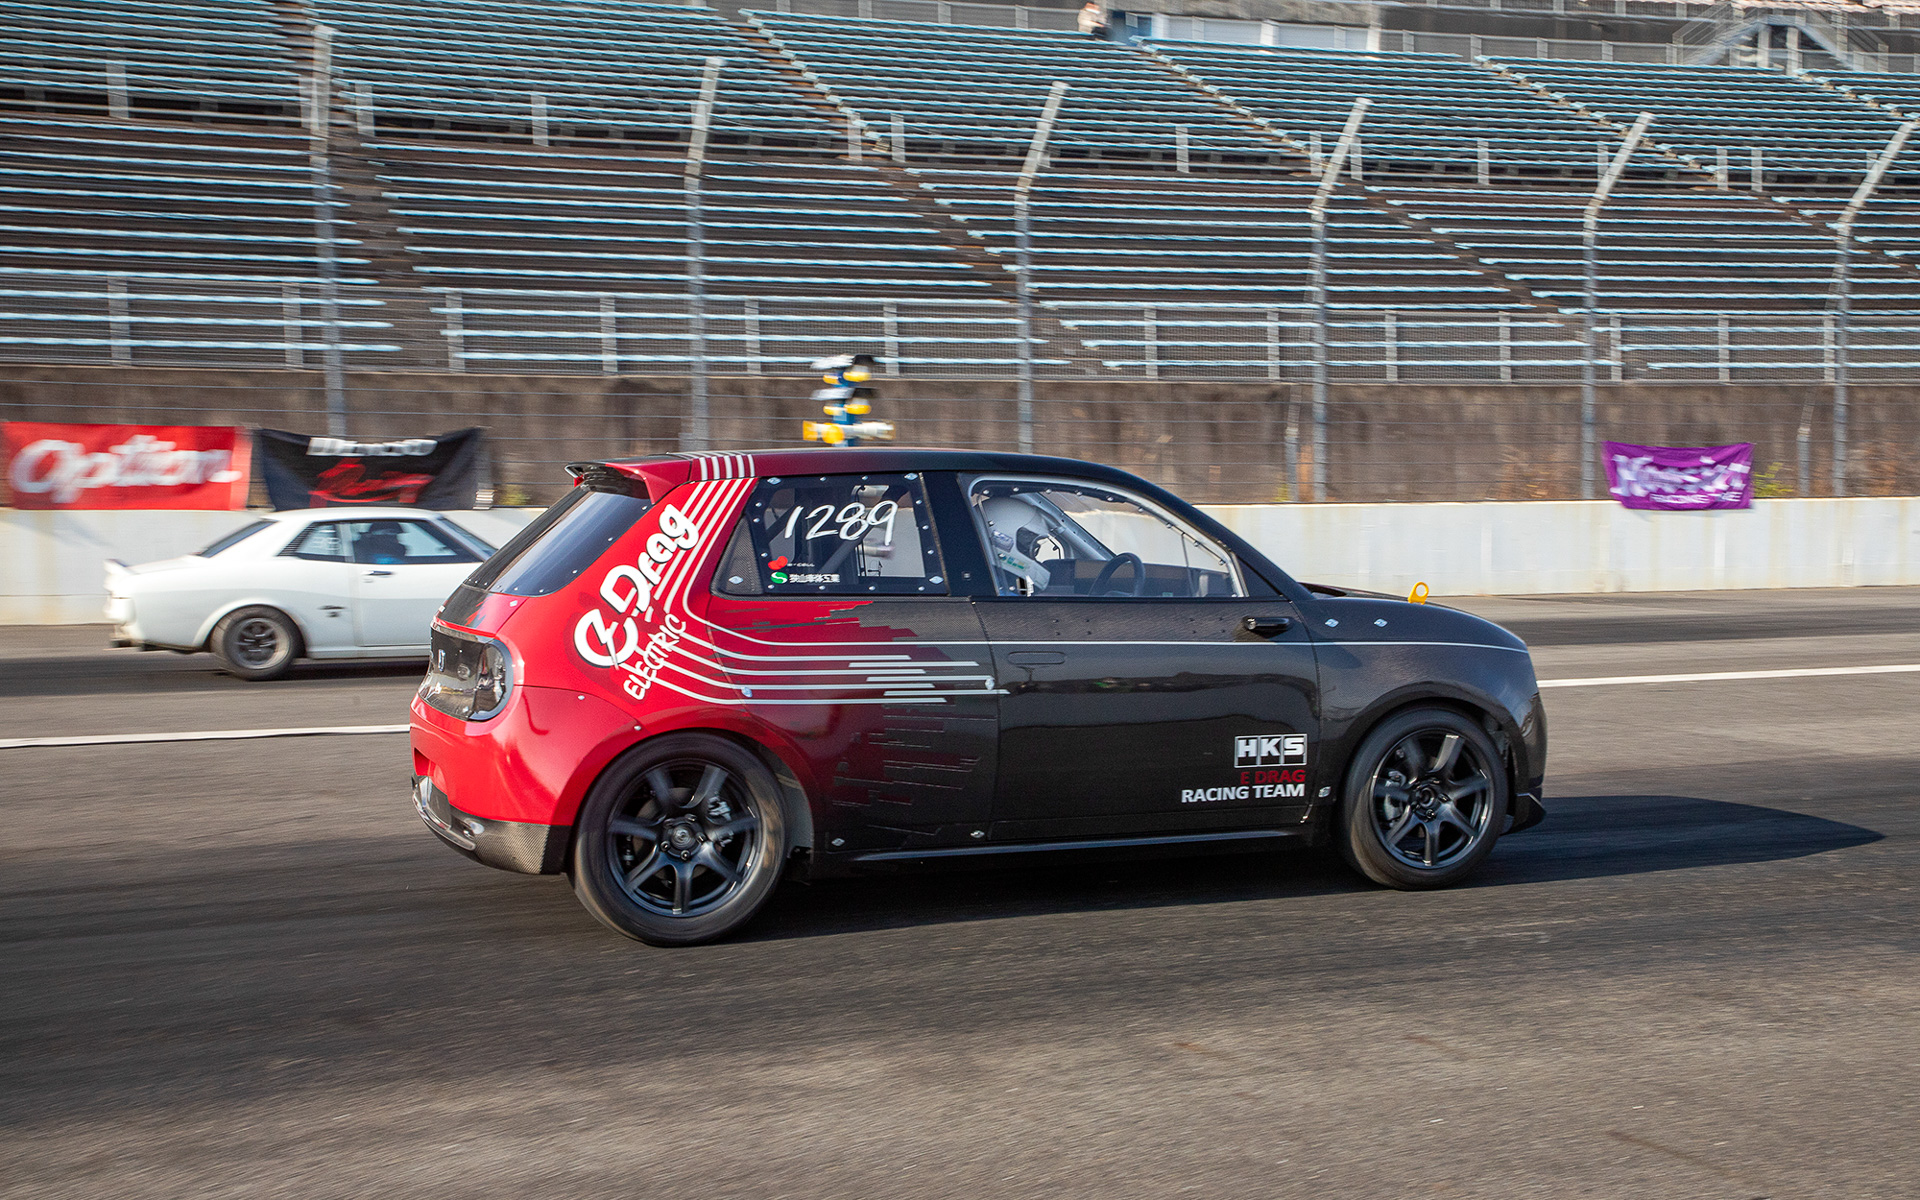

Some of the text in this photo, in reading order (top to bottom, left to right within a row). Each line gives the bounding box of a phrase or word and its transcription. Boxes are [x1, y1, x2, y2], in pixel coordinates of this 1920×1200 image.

[784, 500, 899, 546] 1289
[623, 613, 687, 701] ELECTRIC
[1236, 736, 1305, 759] HKS
[1240, 769, 1306, 785] E DRAG
[1181, 783, 1305, 804] RACING TEAM
